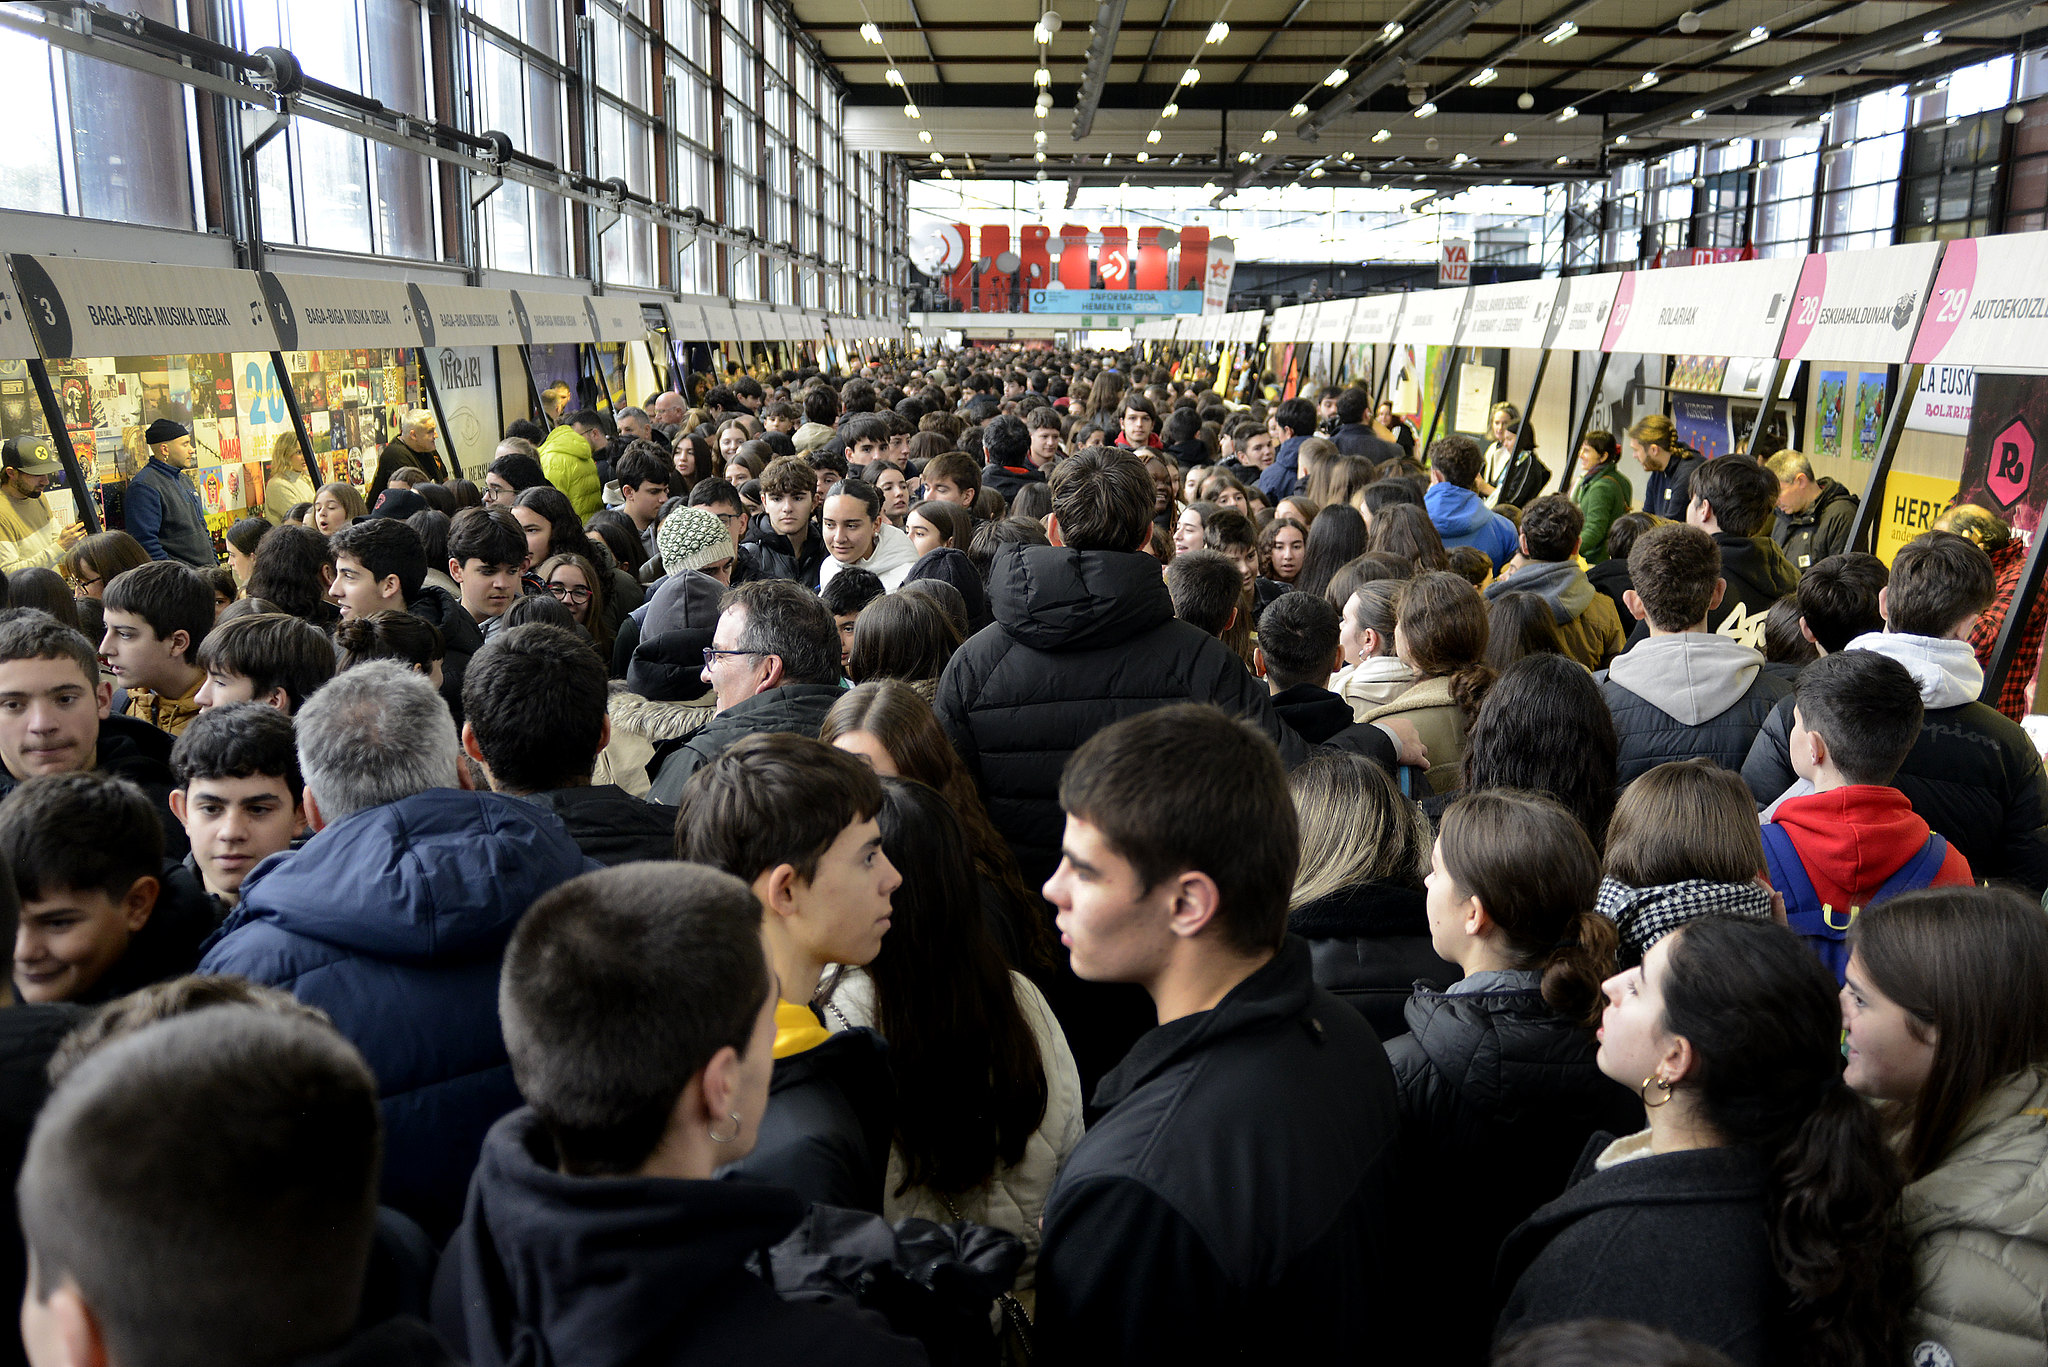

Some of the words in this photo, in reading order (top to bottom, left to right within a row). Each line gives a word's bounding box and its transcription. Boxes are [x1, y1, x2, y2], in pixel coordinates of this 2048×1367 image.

[1444, 246, 1469, 263] YA
[1441, 264, 1468, 280] NIZ
[40, 297, 56, 326] 3
[279, 303, 288, 325] 4
[1614, 304, 1630, 326] 27
[1797, 295, 1819, 325] 28
[1936, 288, 1968, 322] 29
[87, 305, 156, 326] BAGA-BIGA
[153, 306, 198, 326] MUSIKA
[195, 308, 231, 326] IDEIAK
[305, 308, 346, 325] BAGA-BIGA
[343, 309, 372, 325] MUSIKA
[370, 310, 392, 325] IDEIAK
[420, 309, 429, 328] 5
[1658, 306, 1699, 325] ROLARIAK
[1818, 306, 1894, 325] ESKUAHALDUNAK
